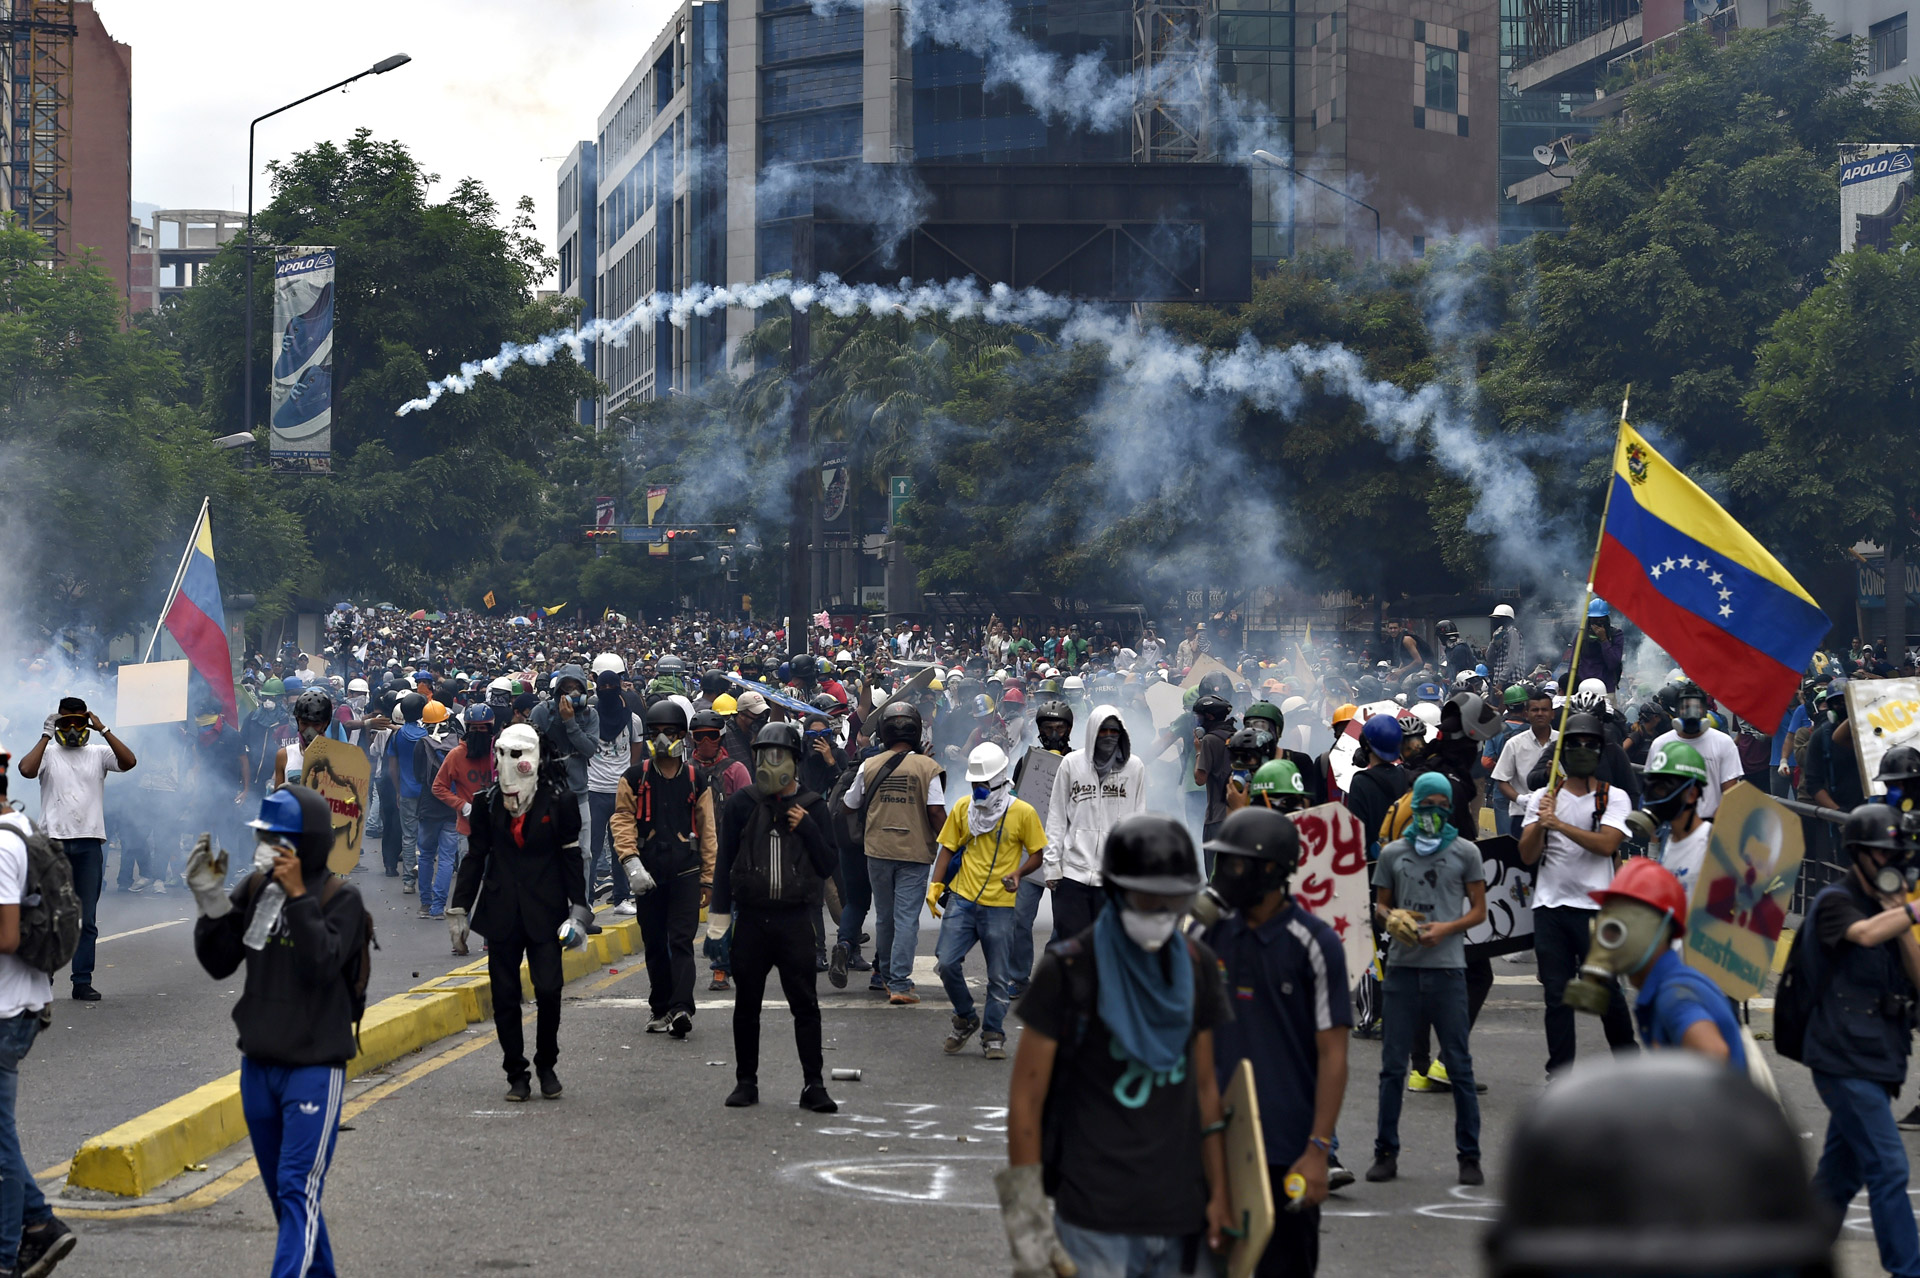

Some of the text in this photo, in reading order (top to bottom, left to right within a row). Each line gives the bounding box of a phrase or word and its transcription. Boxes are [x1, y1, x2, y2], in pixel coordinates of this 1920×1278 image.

[1842, 160, 1888, 181] APOLO
[277, 258, 315, 274] APOLO
[1253, 781, 1275, 790] CALLE
